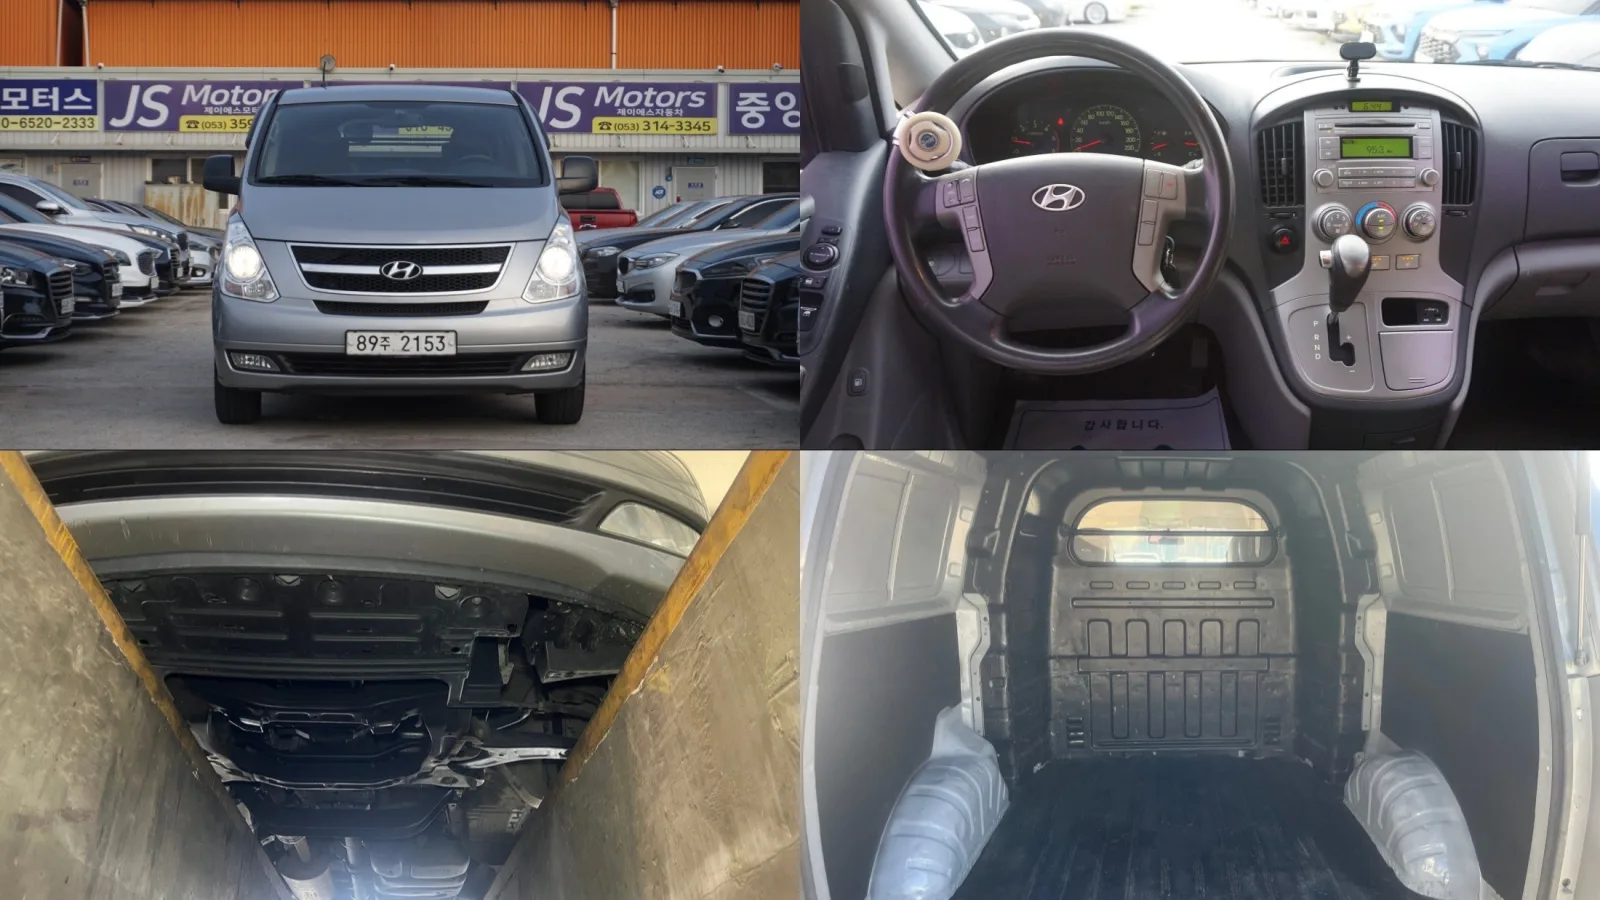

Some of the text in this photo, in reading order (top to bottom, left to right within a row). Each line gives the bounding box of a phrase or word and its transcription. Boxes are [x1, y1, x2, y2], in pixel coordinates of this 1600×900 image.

[0, 86, 93, 112] 모터스
[593, 86, 707, 108] Motors
[109, 84, 279, 128] JS Motor
[1, 117, 95, 129] 0-6520-2333
[201, 120, 227, 130] (053)
[613, 120, 711, 132] (053) 314-3345
[356, 335, 446, 352] 89주 2153
